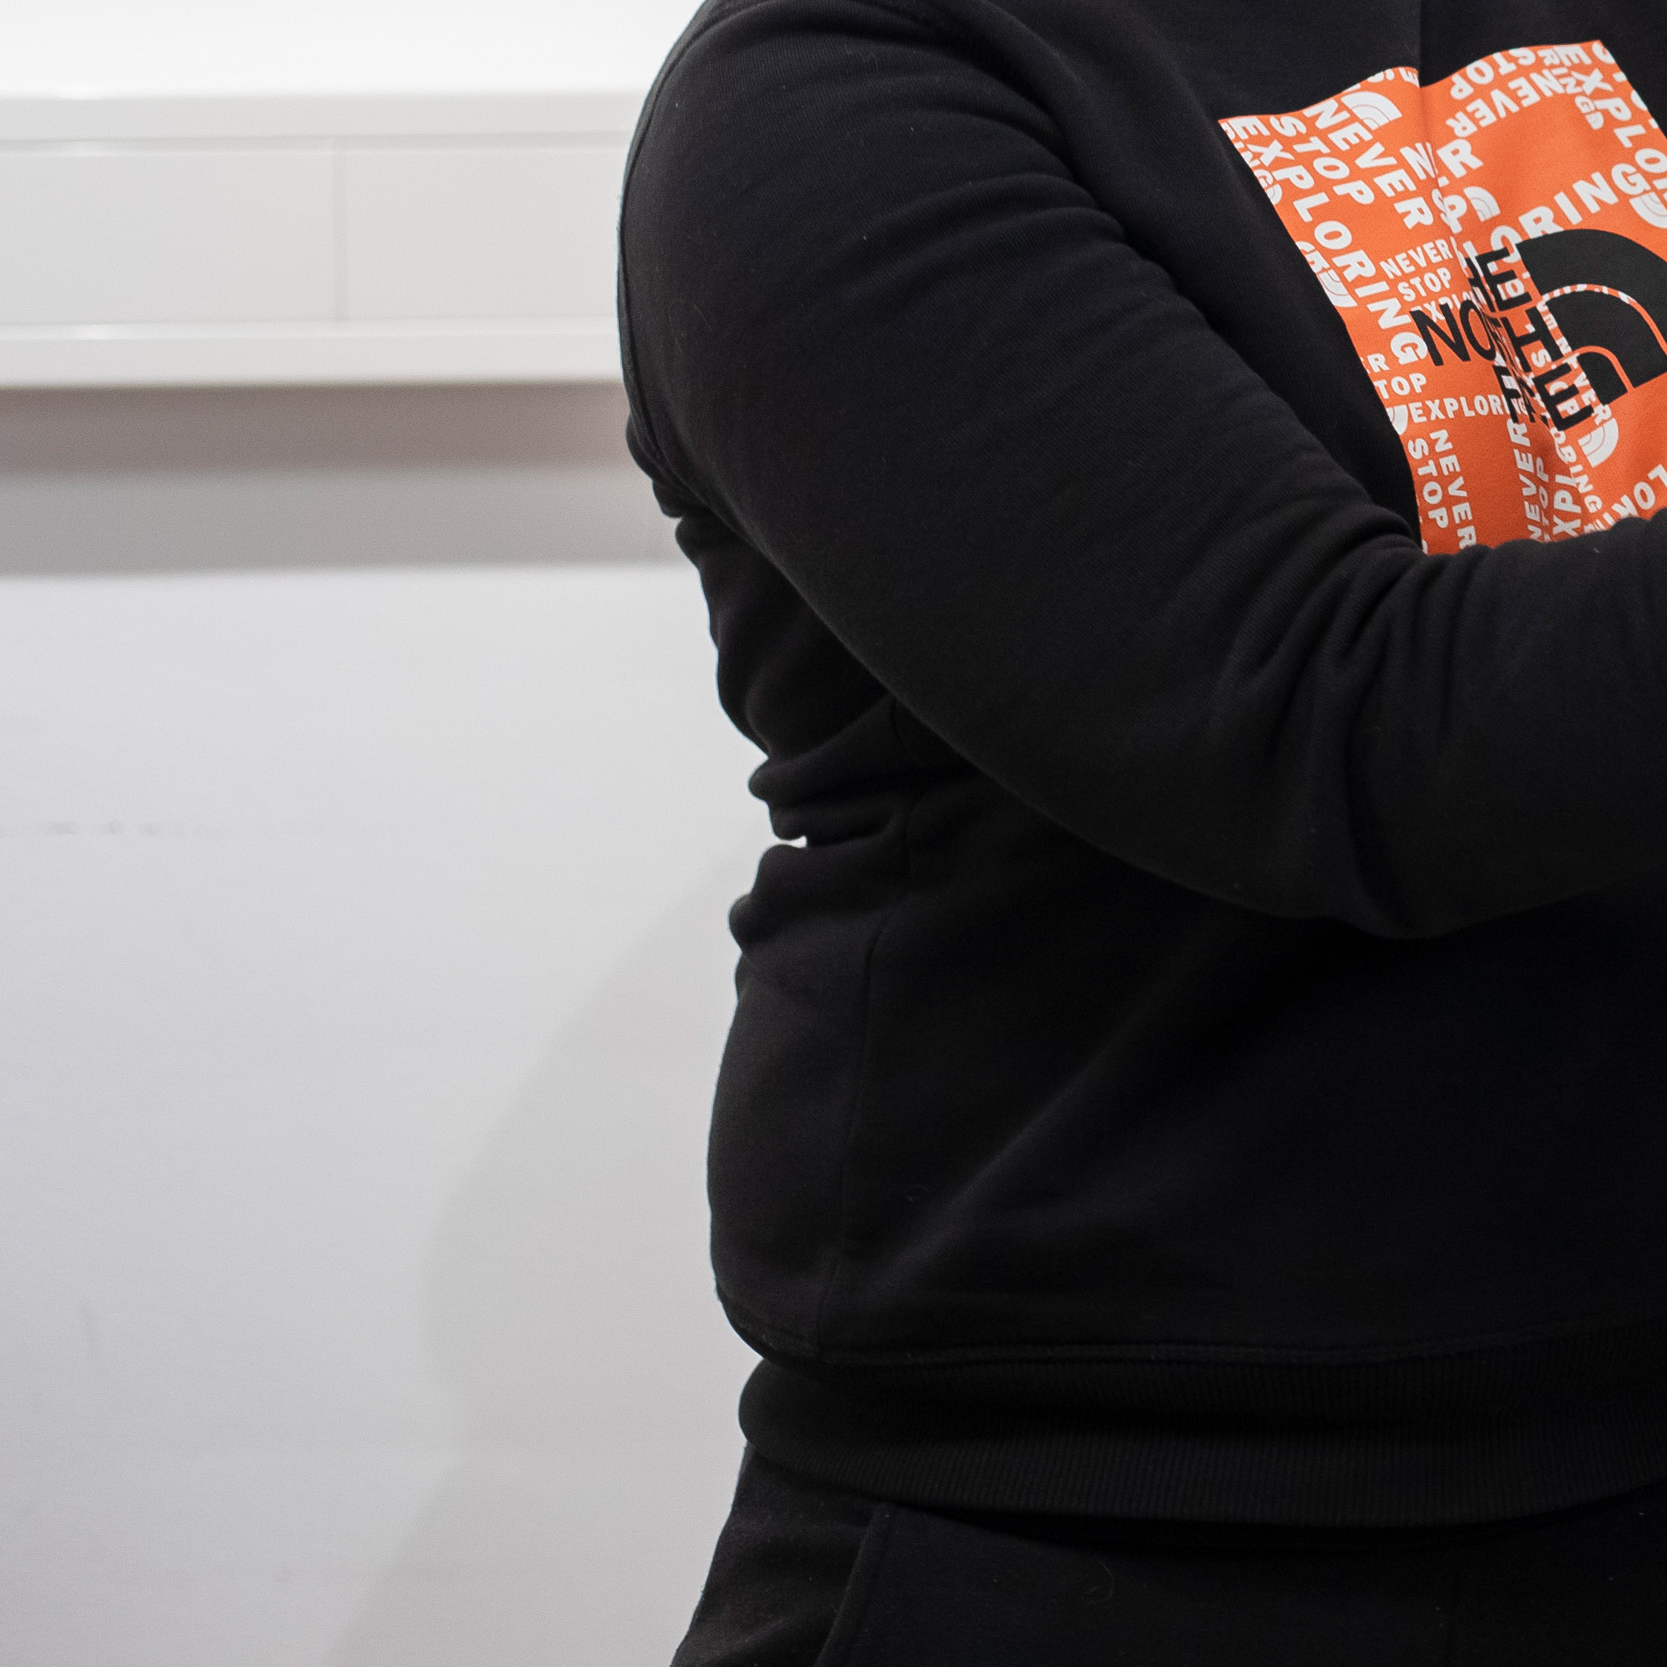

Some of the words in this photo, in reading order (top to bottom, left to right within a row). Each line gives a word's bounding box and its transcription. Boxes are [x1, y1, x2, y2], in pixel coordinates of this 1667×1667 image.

[1446, 69, 1565, 138] NEVER
[1269, 115, 1375, 205] STOP
[1302, 99, 1434, 230] NEVER
[1227, 117, 1429, 366] EXPLORING
[1379, 238, 1454, 280] NEVER
[1397, 267, 1452, 302] STOP
[1373, 372, 1427, 400] TOP
[1408, 438, 1449, 529] STOP
[1430, 429, 1478, 550] NEVER
[1506, 418, 1542, 541] NEVER
